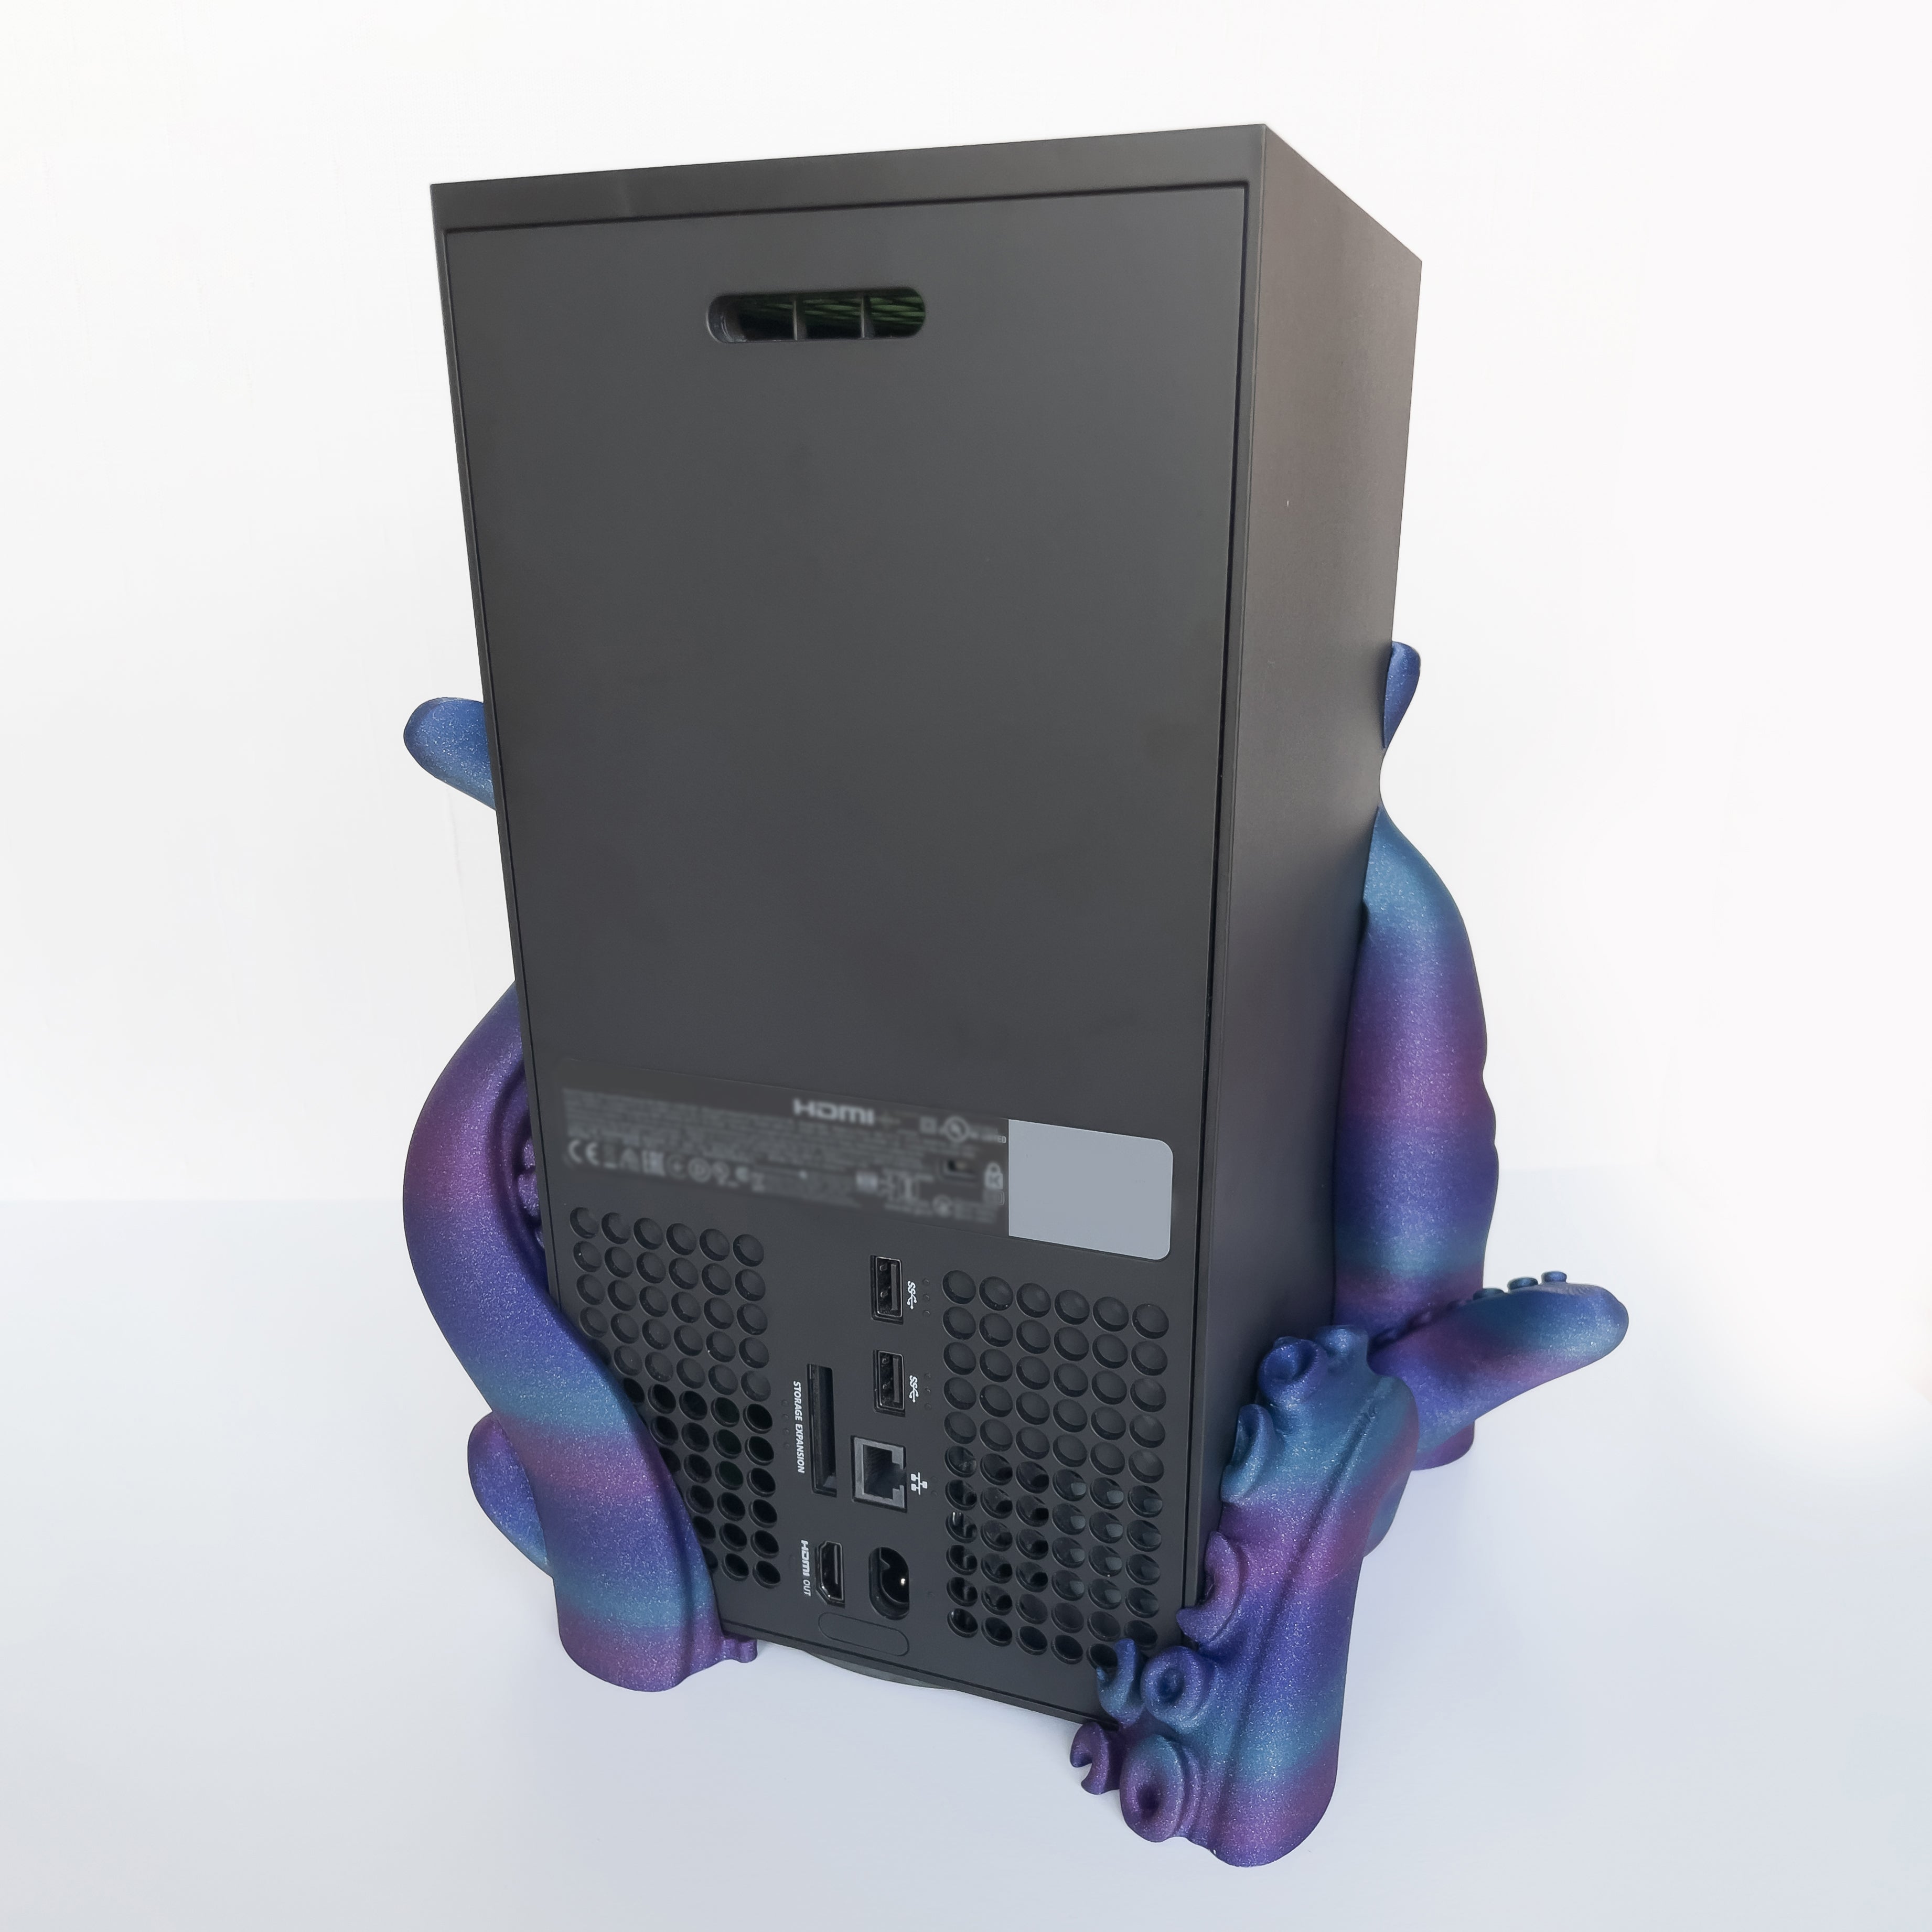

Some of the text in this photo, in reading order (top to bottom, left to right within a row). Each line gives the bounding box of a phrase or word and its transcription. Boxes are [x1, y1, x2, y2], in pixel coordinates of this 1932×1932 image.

[793, 1381, 805, 1474] STORAGE EXPANSION
[801, 1540, 811, 1597] HDMI OUT
